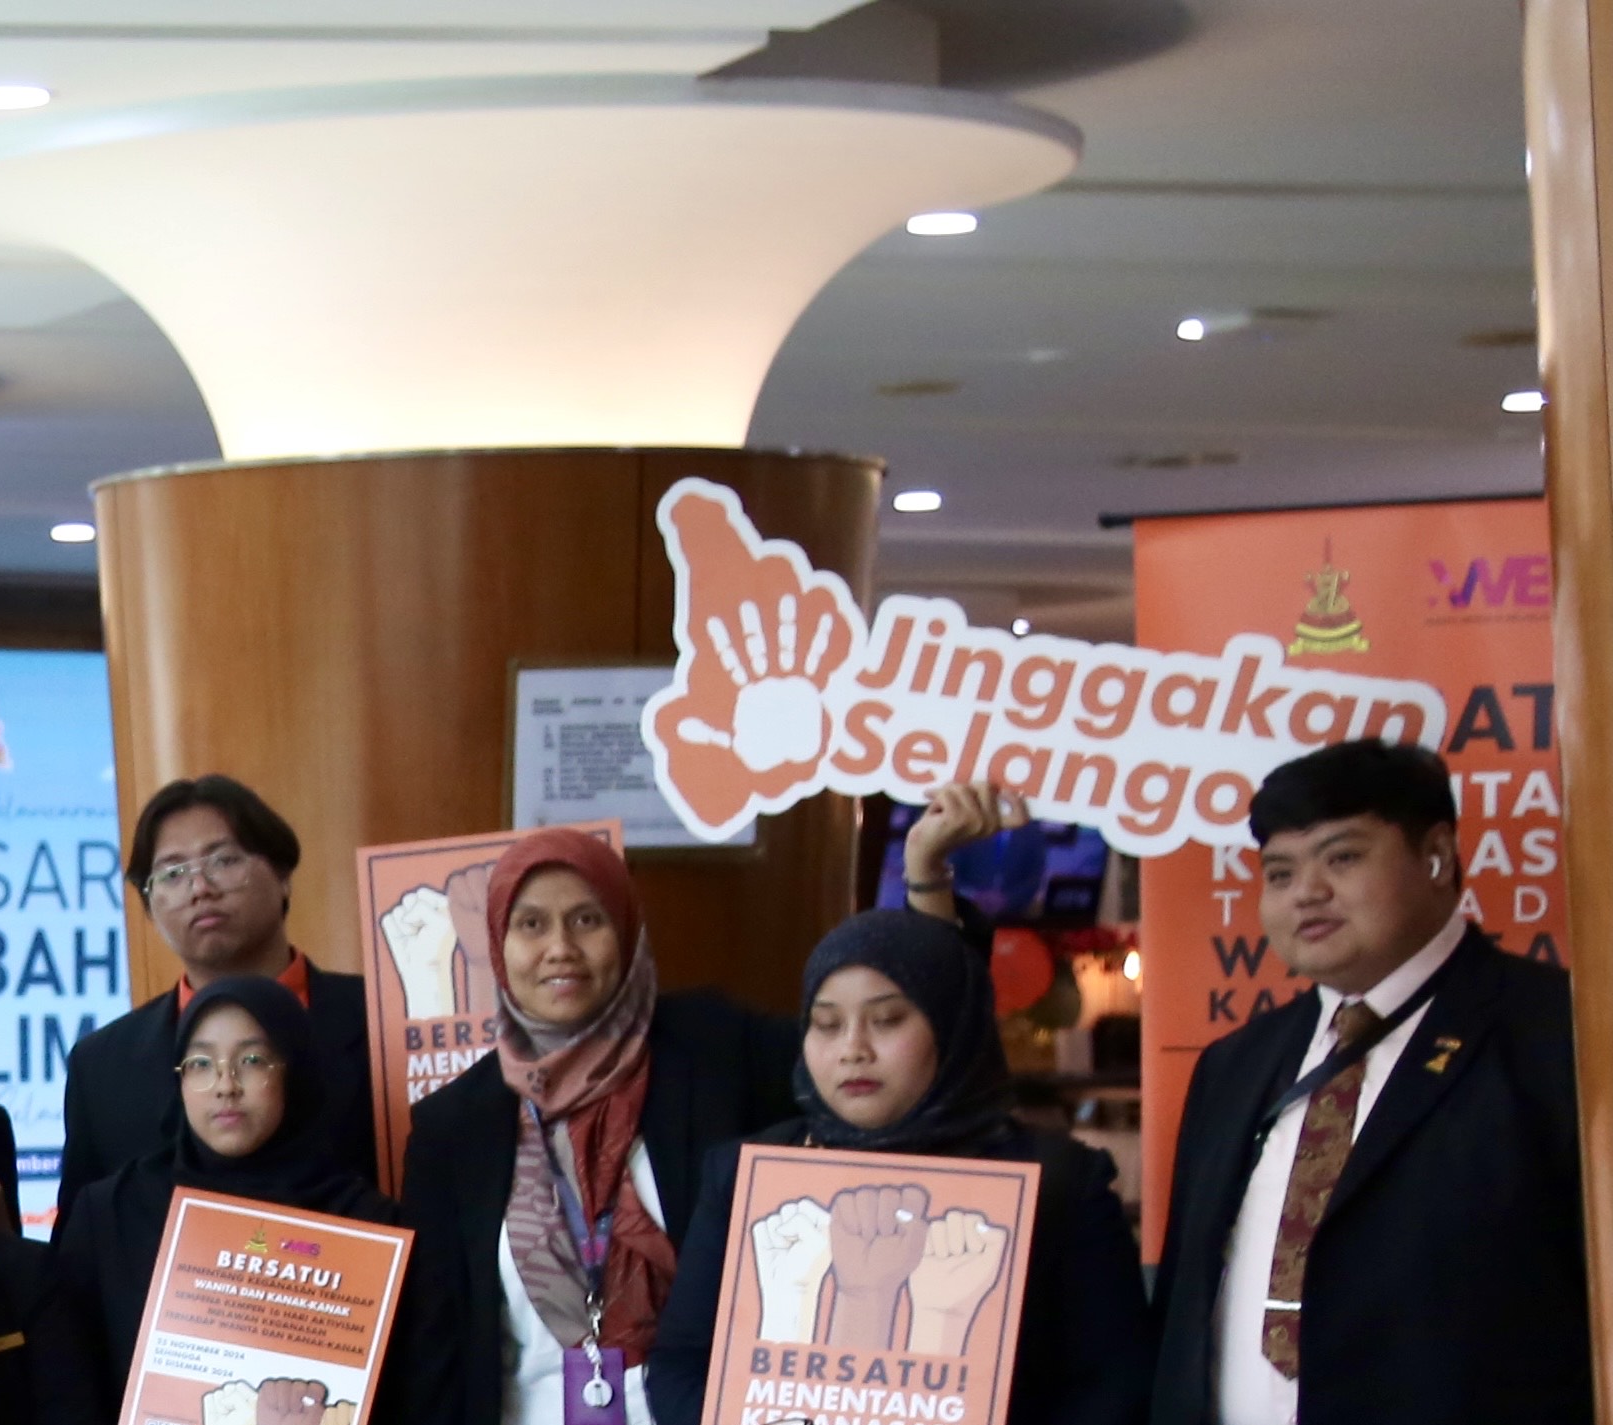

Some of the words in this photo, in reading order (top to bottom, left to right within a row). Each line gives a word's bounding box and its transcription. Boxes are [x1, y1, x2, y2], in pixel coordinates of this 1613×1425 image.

[857, 616, 1429, 749] Jinggakan
[830, 701, 1255, 837] Selango
[217, 1250, 341, 1289] BERSATU!
[195, 1278, 237, 1295] WANITA
[240, 1287, 264, 1299] DAN
[266, 1292, 351, 1317] KANAK-KANAK
[248, 1277, 315, 1296] KEGANASAN
[319, 1290, 374, 1307] TERHADAP
[262, 1318, 327, 1335] KEGANASAN
[283, 1310, 309, 1321] HARI
[312, 1316, 366, 1333] AKTIVISME
[170, 1340, 219, 1354] NOVEMBER
[223, 1350, 245, 1359] 2024
[262, 1329, 283, 1339] DAN
[287, 1334, 365, 1355] KANAK-KANAK
[212, 1368, 233, 1377] 2024
[751, 1348, 968, 1392] BERSATU!
[745, 1379, 965, 1422] MENENTANG
